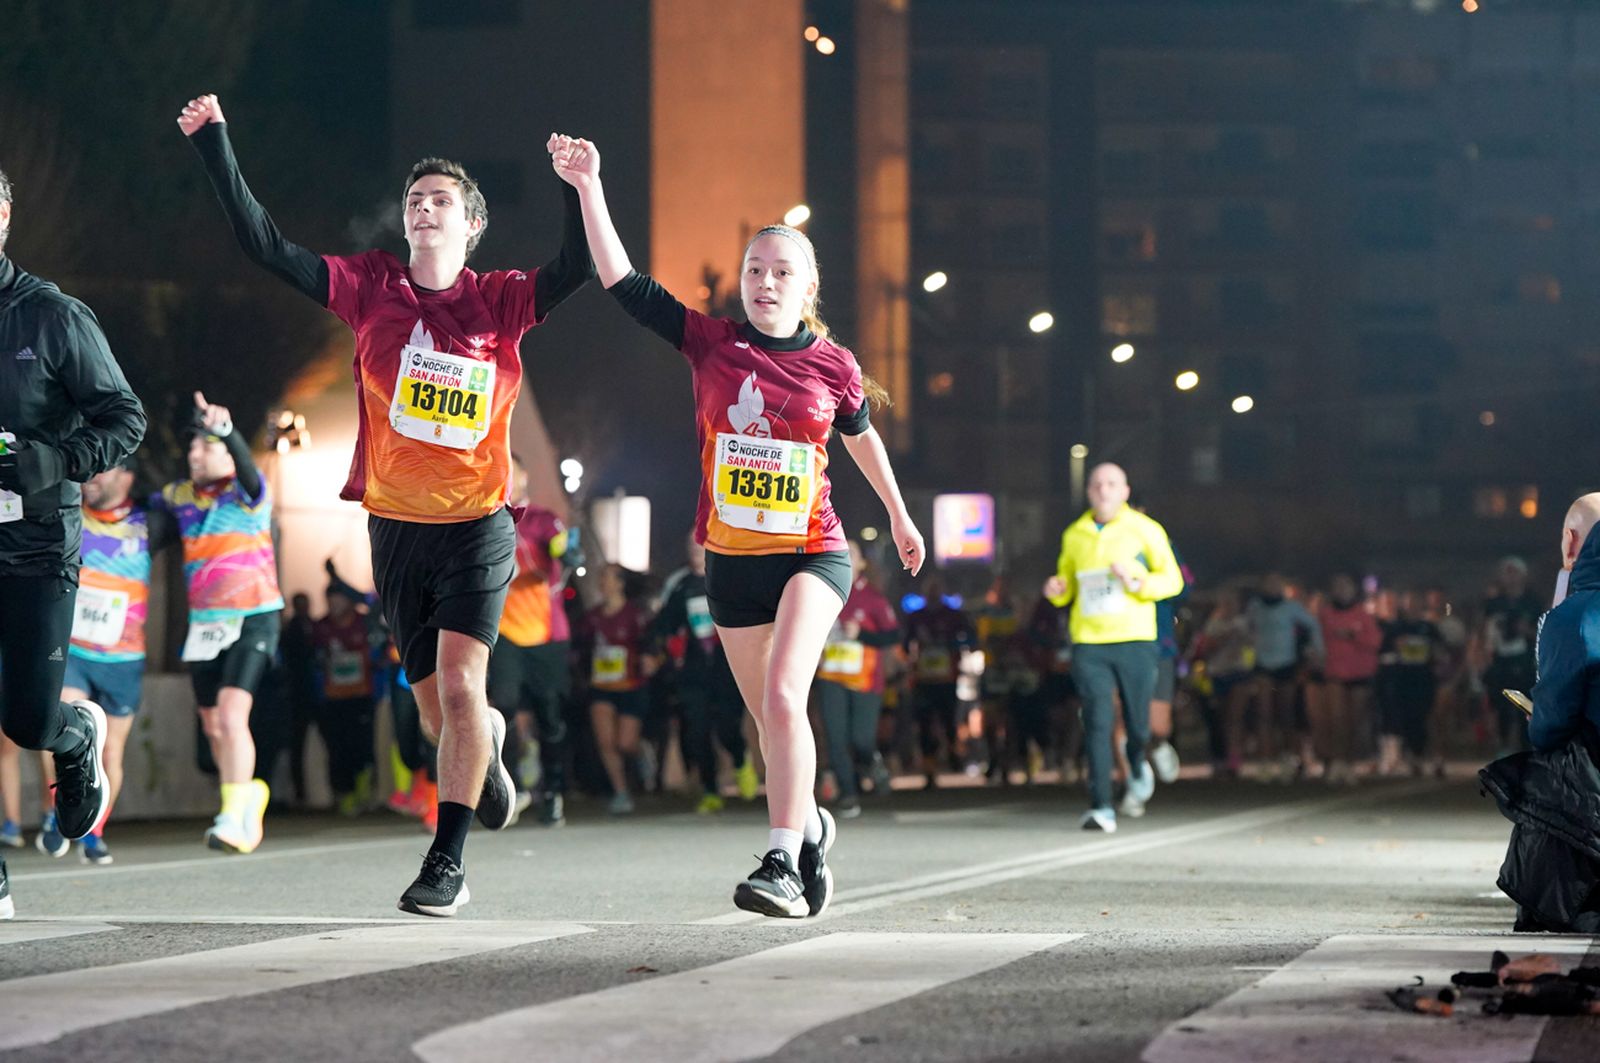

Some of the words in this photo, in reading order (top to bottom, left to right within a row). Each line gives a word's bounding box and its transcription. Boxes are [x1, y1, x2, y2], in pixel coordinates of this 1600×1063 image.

[422, 360, 452, 374] NOCHE
[452, 366, 464, 377] DE
[409, 368, 428, 381] SAN
[428, 373, 462, 388] ANTÓN
[410, 381, 478, 420] 13104
[739, 446, 769, 459] NOCHE
[770, 450, 783, 460] DE
[727, 455, 746, 467] SAN
[748, 457, 782, 472] ANTÓN
[728, 468, 800, 503] 13318
